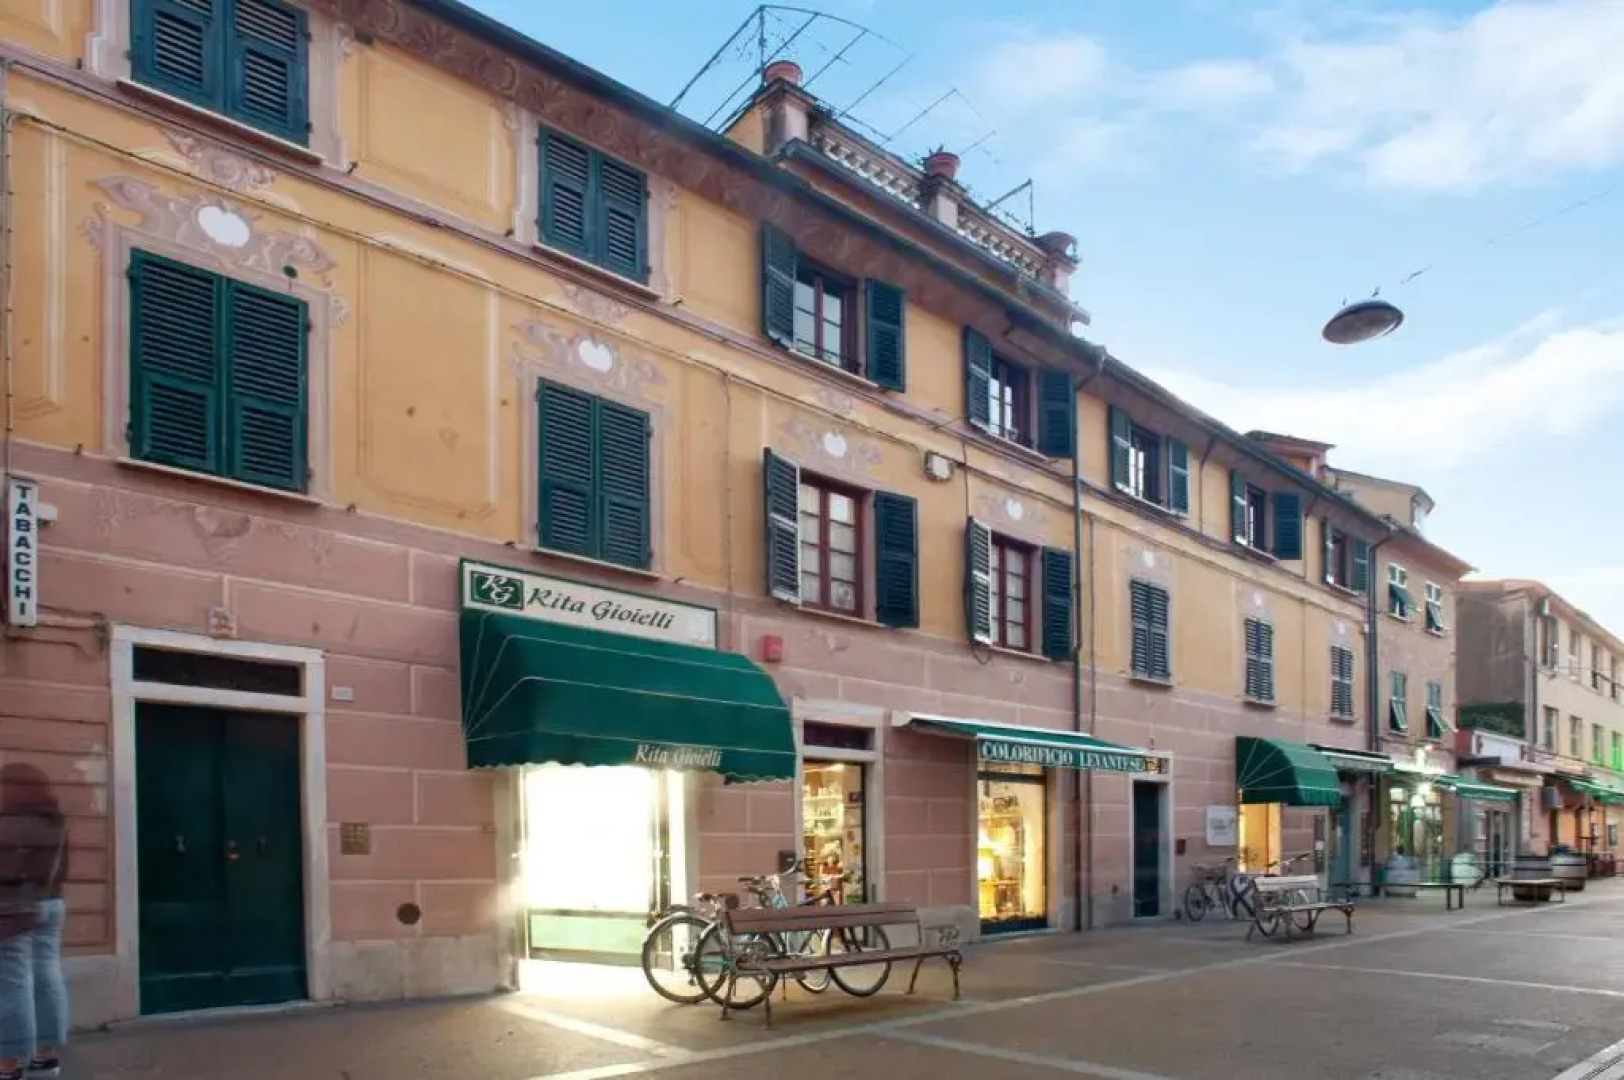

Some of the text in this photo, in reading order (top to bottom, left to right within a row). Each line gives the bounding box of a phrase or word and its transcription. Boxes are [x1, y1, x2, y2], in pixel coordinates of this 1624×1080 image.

[14, 484, 32, 616] TABACCHI
[526, 587, 675, 629] Rita Gioielli
[635, 743, 668, 764] Rita
[981, 740, 1144, 774] COLORIFICIO LEVANTESE
